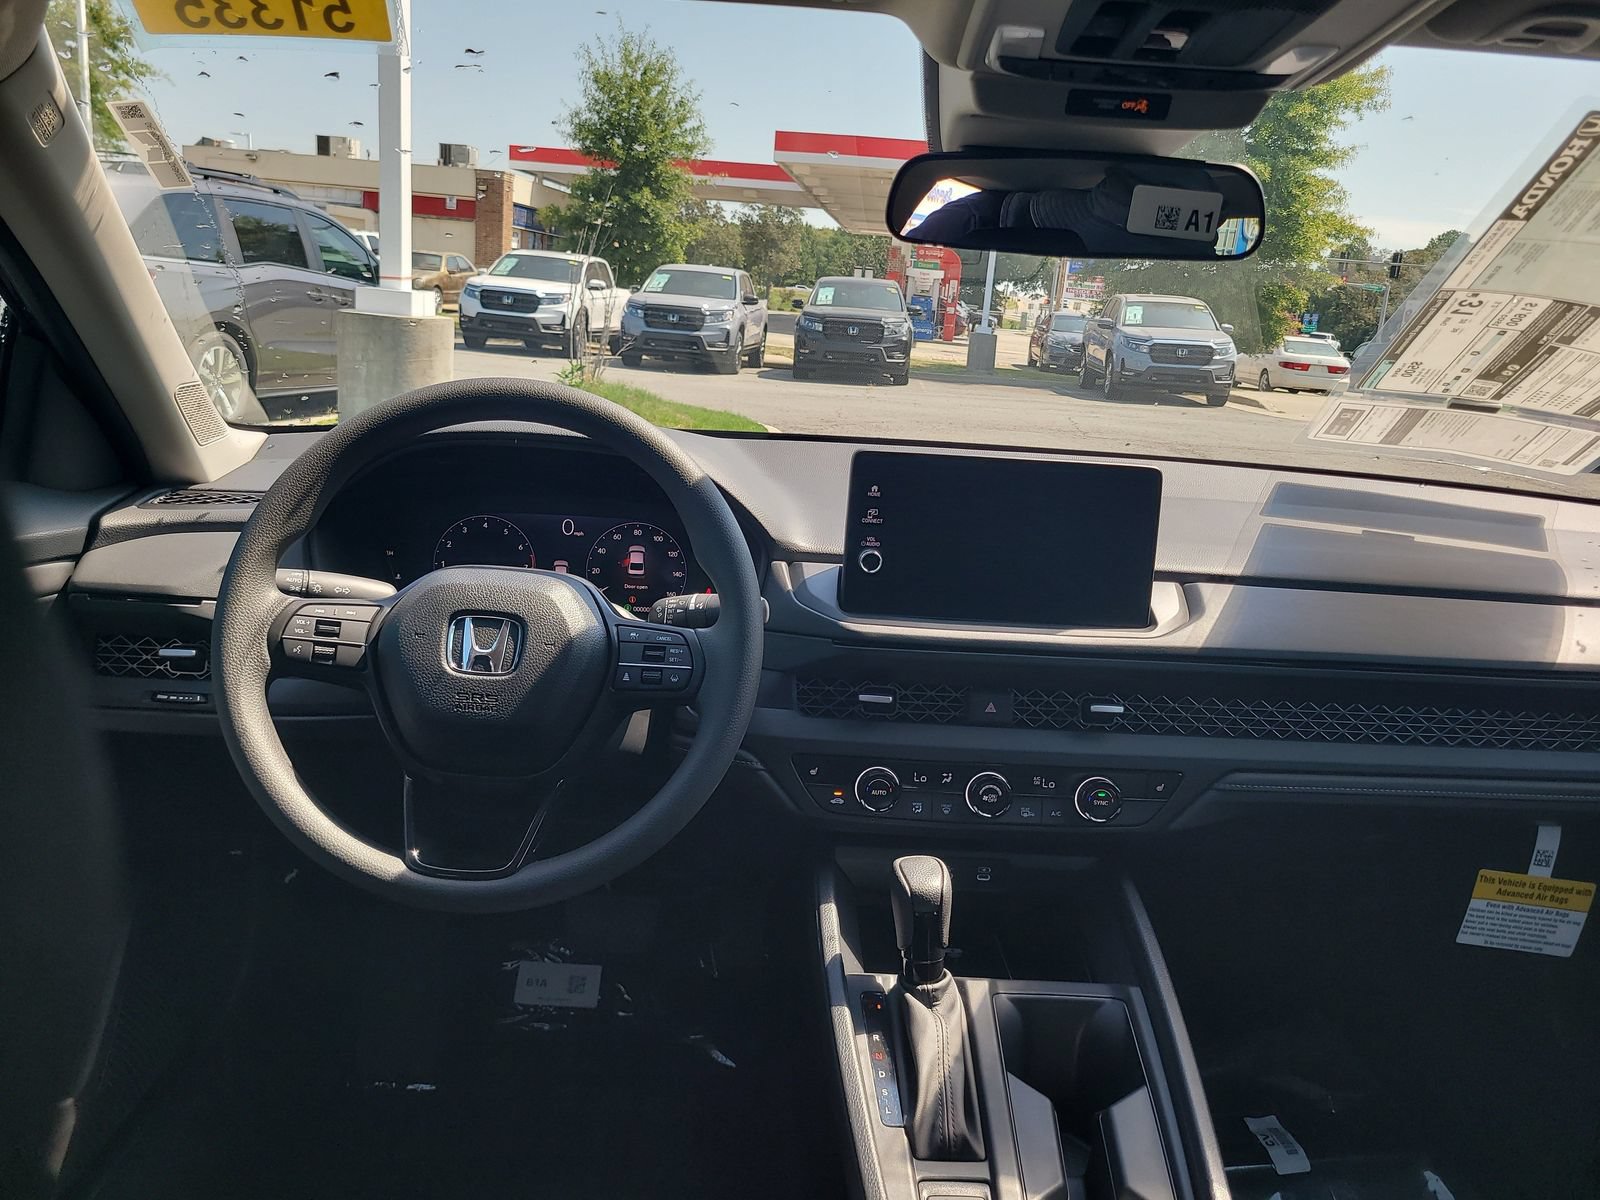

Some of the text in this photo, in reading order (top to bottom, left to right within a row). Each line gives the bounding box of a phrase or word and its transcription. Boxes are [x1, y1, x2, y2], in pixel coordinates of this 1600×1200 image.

[1120, 101, 1136, 110] OFF
[1184, 210, 1215, 234] A1
[561, 518, 575, 536] 0
[612, 533, 622, 541] 60
[455, 692, 499, 703] SRS
[913, 772, 927, 783] Lo
[1042, 778, 1056, 789] Lo
[1480, 874, 1593, 897] This Vehicle is Equipped with
[1496, 887, 1569, 905] Advanced Air Bags
[1486, 901, 1501, 909] Even
[1501, 903, 1515, 911] with
[1515, 905, 1544, 914] Advanced
[1555, 910, 1570, 918] Bags
[878, 1070, 886, 1078] D
[881, 1088, 888, 1096] S
[885, 1106, 892, 1114] L
